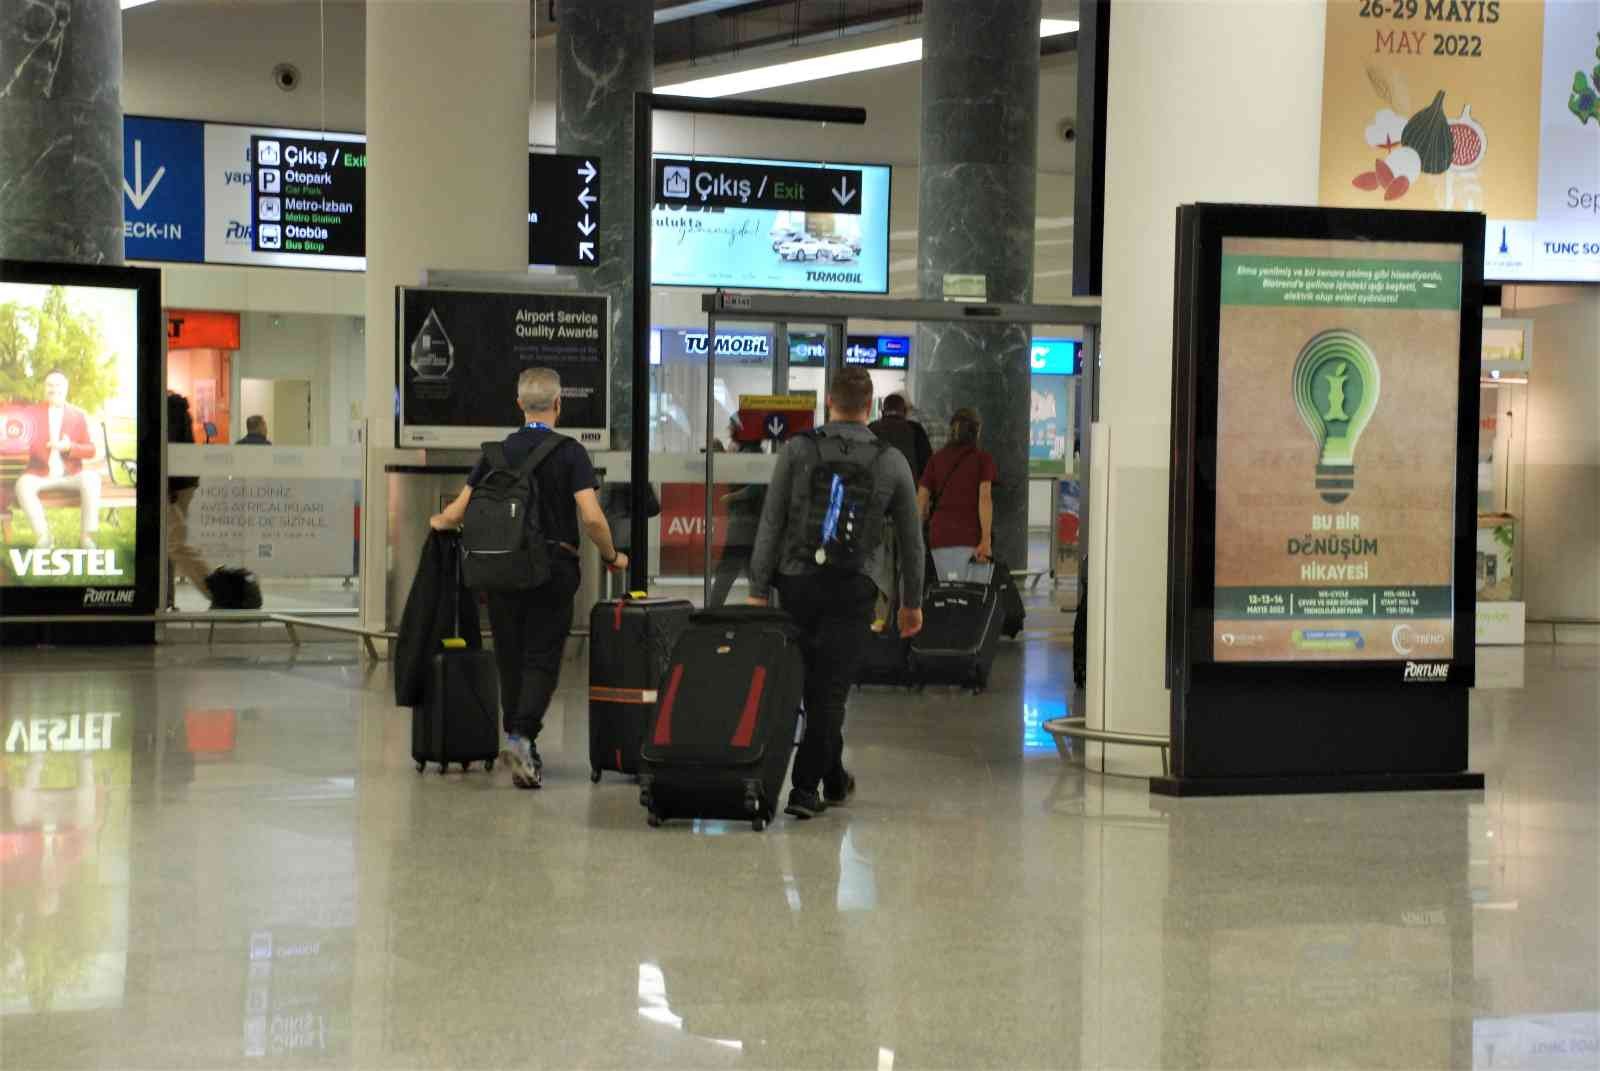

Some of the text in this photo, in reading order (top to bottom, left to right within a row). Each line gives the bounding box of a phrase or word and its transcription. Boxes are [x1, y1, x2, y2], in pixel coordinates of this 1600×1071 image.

[1359, 0, 1500, 23] 26-29 MAYIS
[1375, 29, 1482, 57] MAY 2022
[285, 145, 328, 169] Çıkış
[344, 153, 368, 168] Exit
[285, 169, 332, 185] Otopark
[695, 172, 751, 203] Çıkış
[773, 182, 805, 200] Exit
[285, 225, 328, 240] Otobüs
[515, 308, 598, 325] Airport Service
[515, 324, 599, 340] Quality Awards
[1312, 512, 1360, 531] BU BİR
[9, 549, 124, 576] VESTEL
[1301, 560, 1369, 581] HİKAYESİ
[84, 588, 135, 603] PORTLINE
[1404, 661, 1449, 677] PORTLINE
